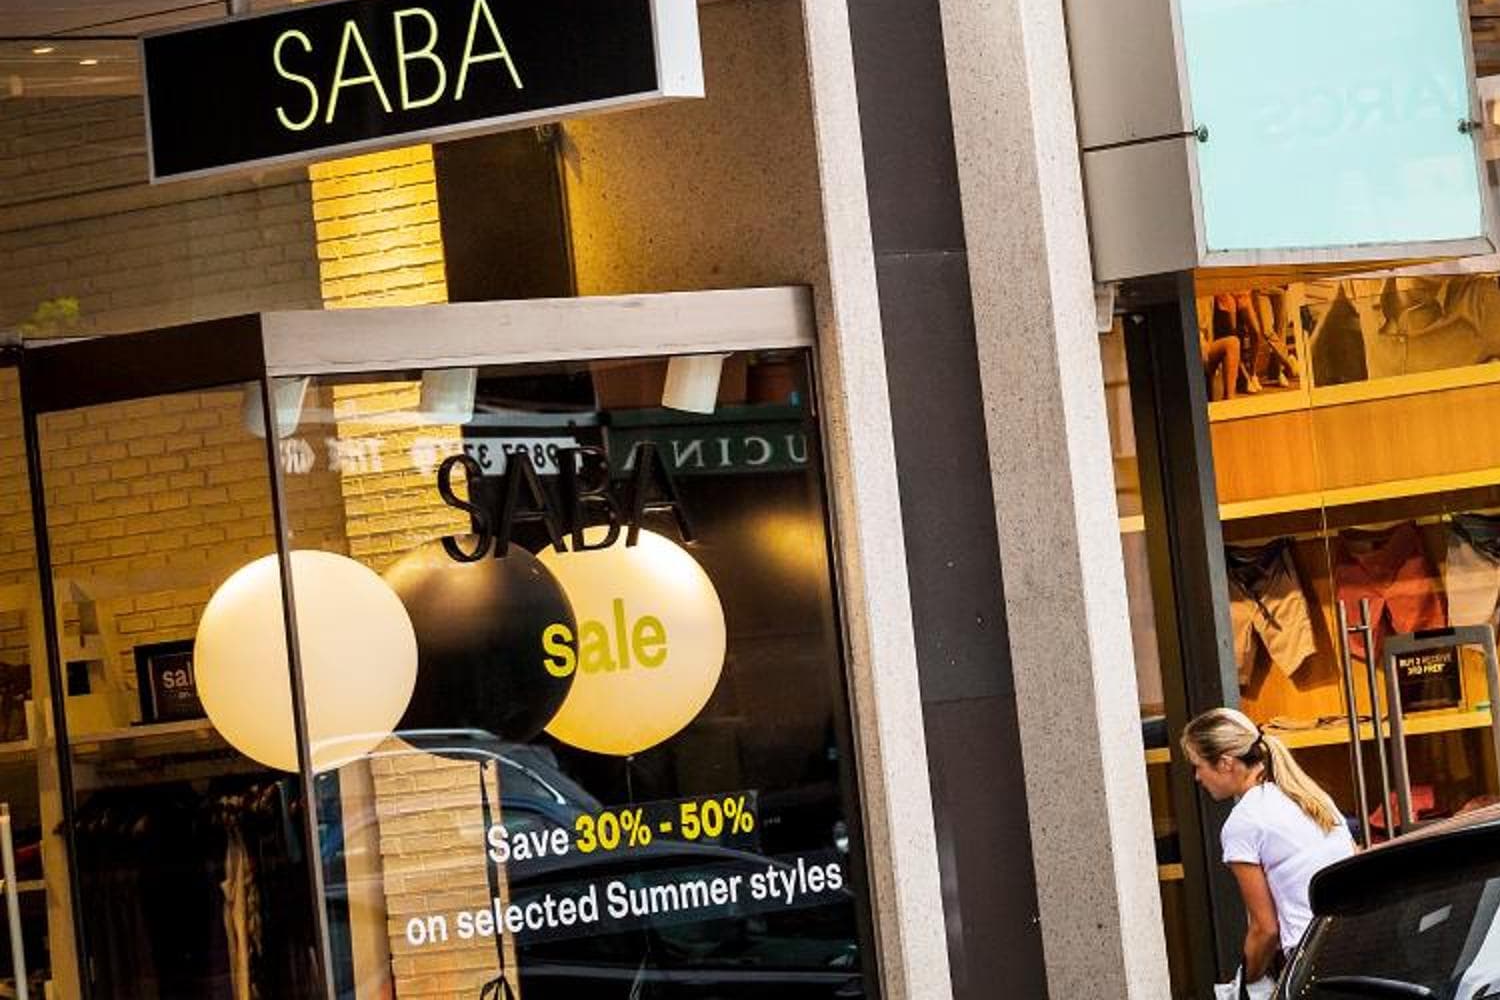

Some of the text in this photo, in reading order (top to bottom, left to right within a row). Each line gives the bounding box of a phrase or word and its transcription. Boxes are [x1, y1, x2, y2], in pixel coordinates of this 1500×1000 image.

[437, 442, 697, 562] SABA
[162, 660, 193, 689] sal
[542, 598, 668, 677] sale
[488, 795, 754, 863] Save 30% - 50%
[406, 857, 843, 946] on selected Summer styles
